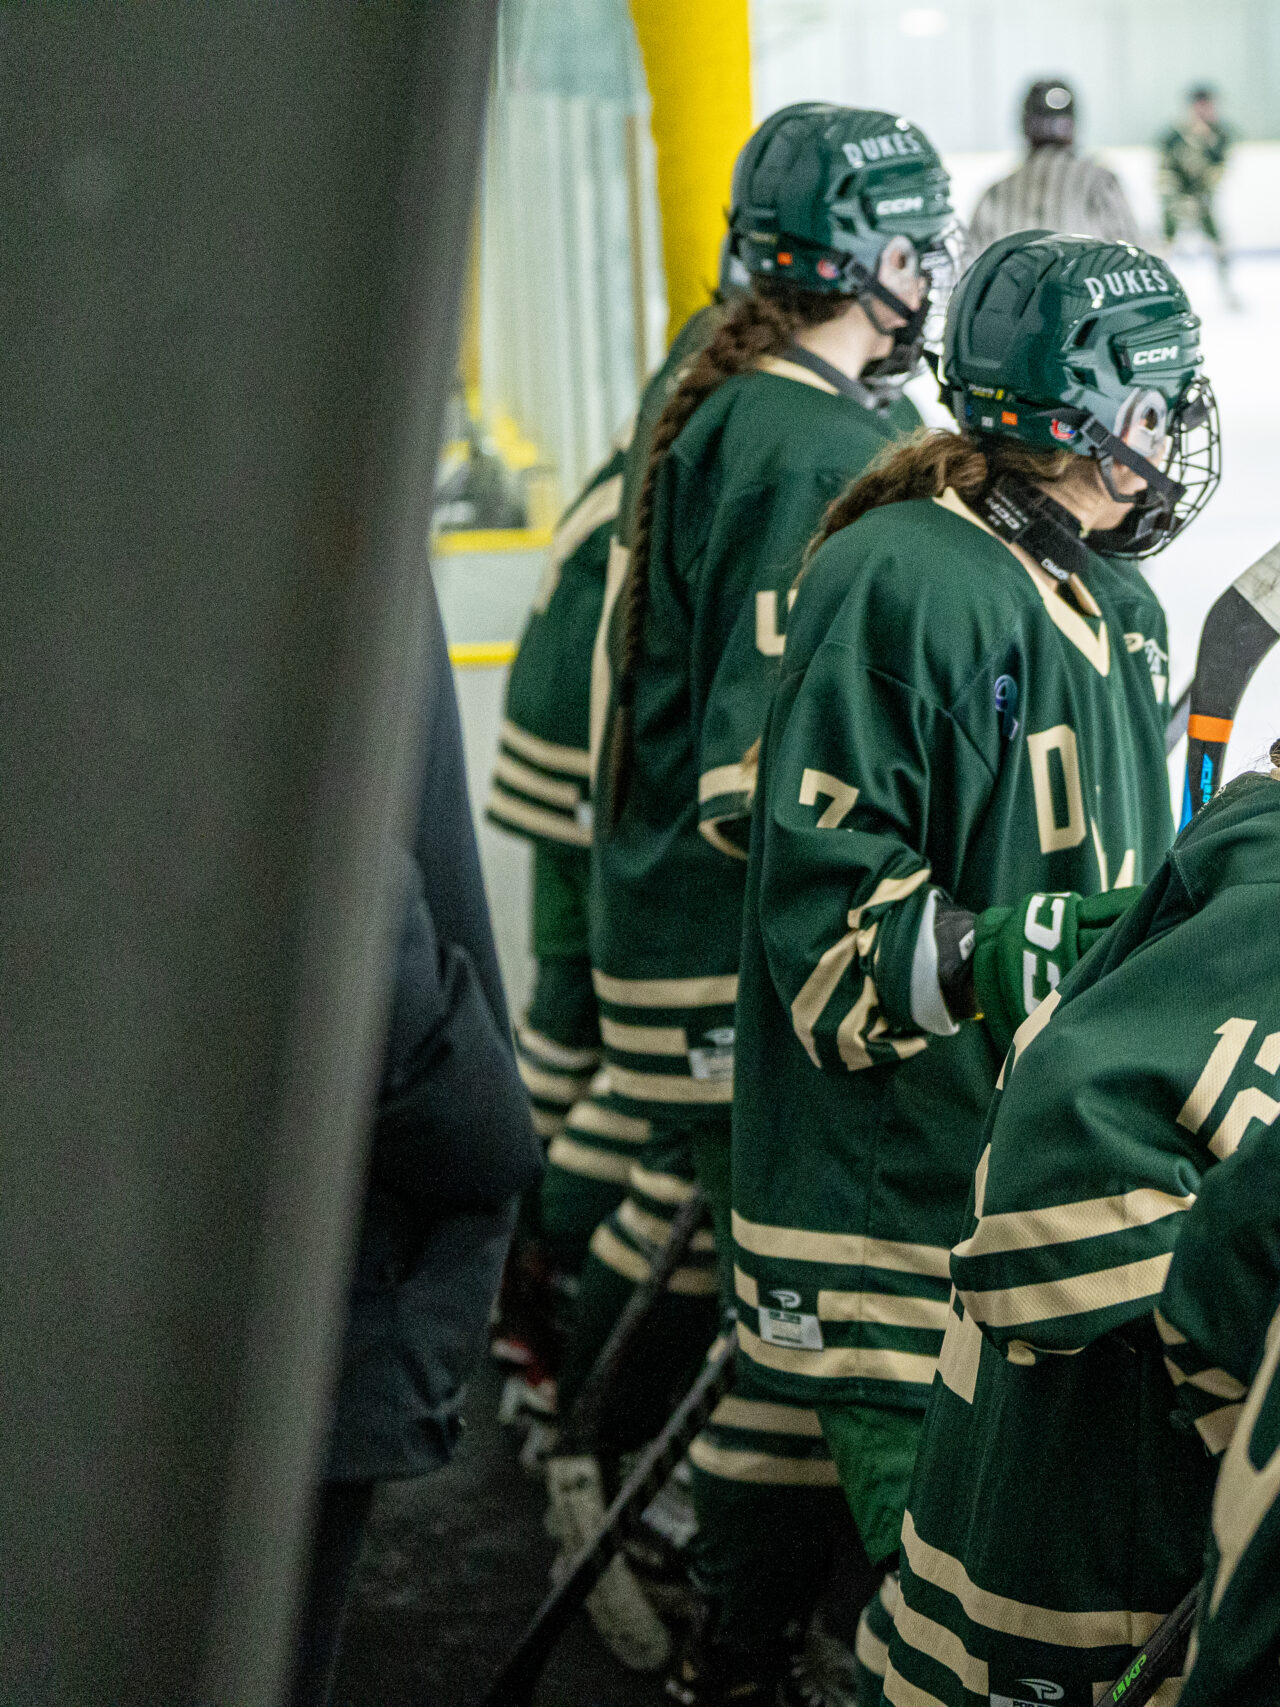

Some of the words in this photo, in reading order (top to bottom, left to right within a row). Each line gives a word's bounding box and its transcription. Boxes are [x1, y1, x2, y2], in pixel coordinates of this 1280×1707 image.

[842, 132, 922, 168] DUKES
[877, 197, 924, 215] CCM
[1084, 269, 1169, 304] DUKES
[1133, 345, 1179, 366] CCM
[799, 768, 860, 829] 7
